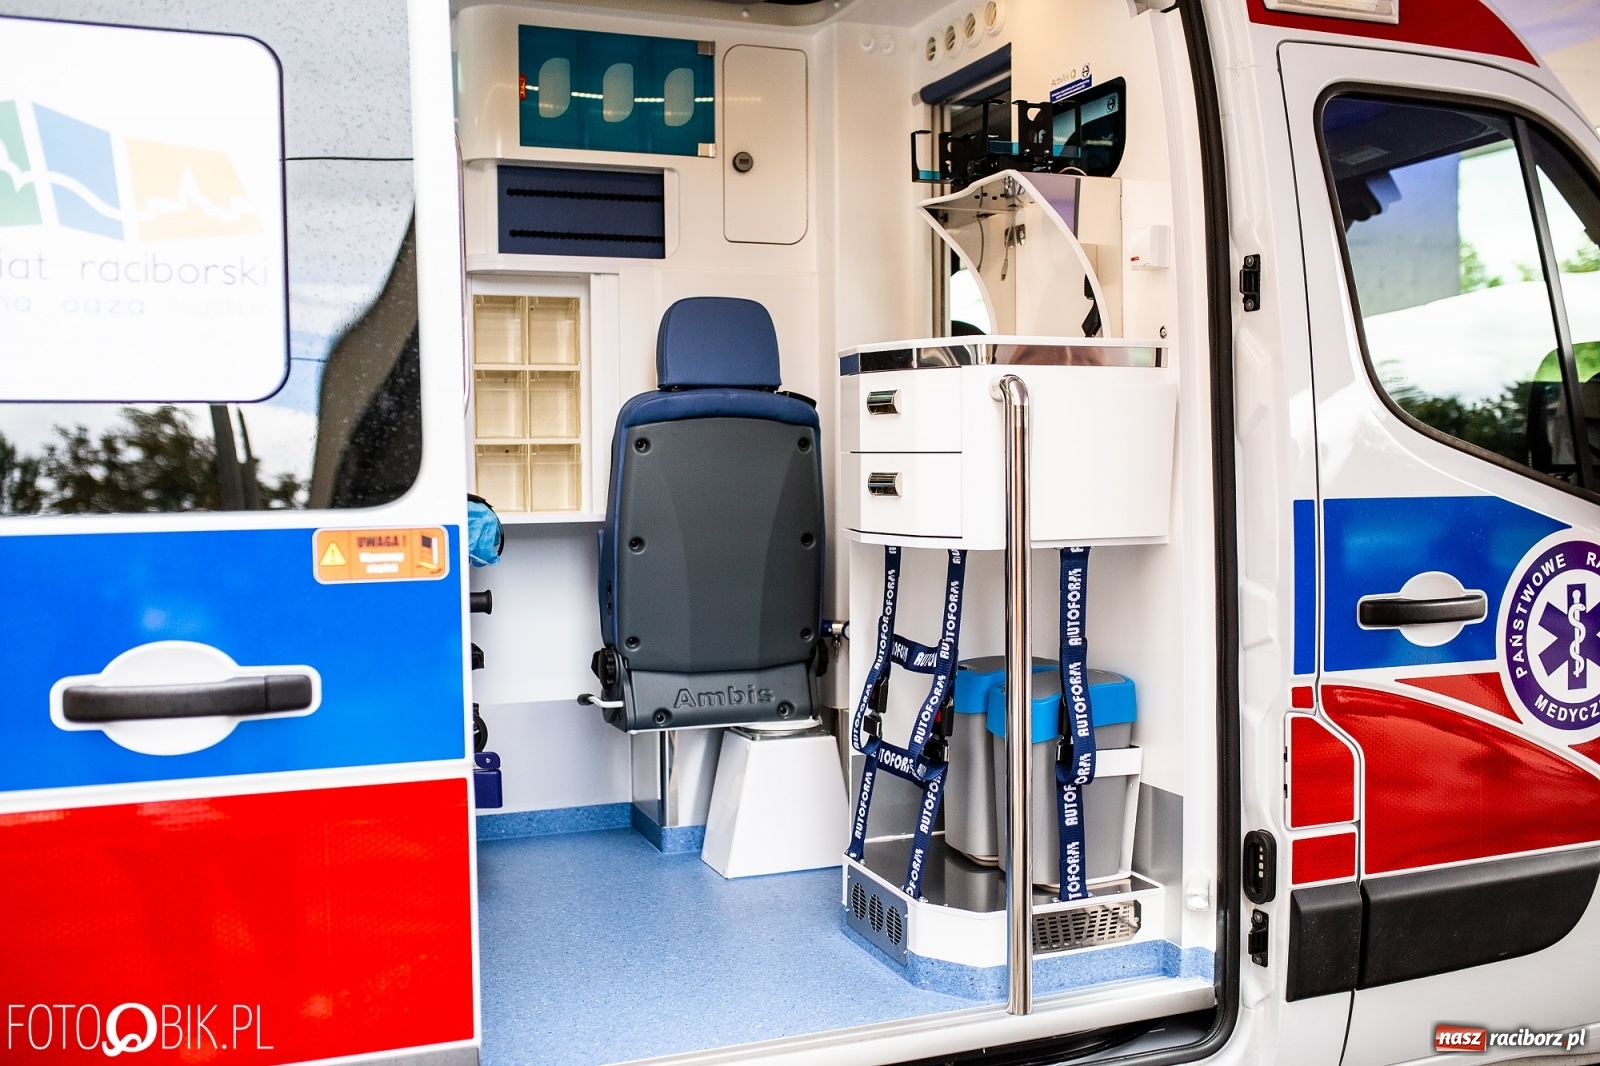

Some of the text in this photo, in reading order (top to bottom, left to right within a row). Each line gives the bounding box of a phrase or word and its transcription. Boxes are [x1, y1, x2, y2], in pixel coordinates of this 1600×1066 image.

[80, 252, 268, 286] raciborski
[61, 297, 145, 315] oaza
[1067, 568, 1082, 646] AUTOFORM
[1509, 553, 1566, 679] PAŃSTWOWE
[674, 685, 775, 708] Ambis
[852, 684, 872, 749] AUTOFORM
[914, 675, 946, 744] AUTOFORM
[1068, 661, 1090, 738] AUTOFORM
[1534, 694, 1600, 722] MEDYCZ
[854, 771, 873, 839] AUTOFORM
